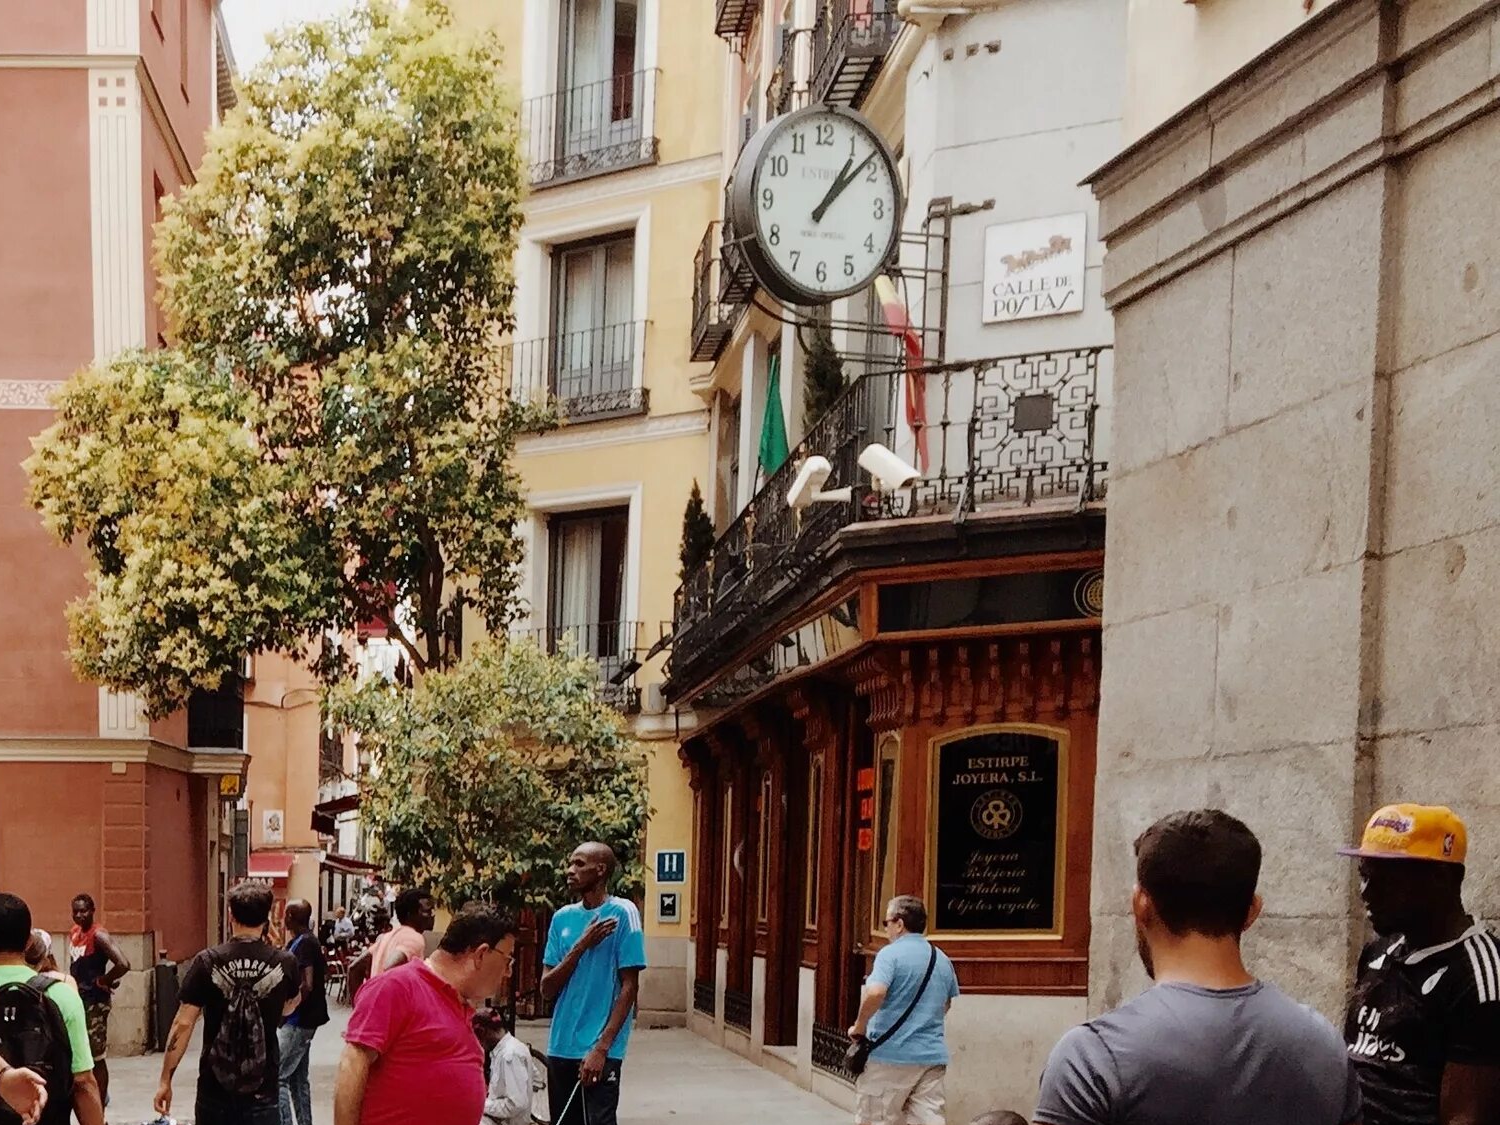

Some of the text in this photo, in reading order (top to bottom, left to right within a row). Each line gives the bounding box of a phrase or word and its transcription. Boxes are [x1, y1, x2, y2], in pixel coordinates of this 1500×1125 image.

[792, 133, 805, 154] 11
[815, 124, 834, 146] 12
[850, 135, 856, 157] 1
[770, 155, 788, 177] 10
[866, 162, 878, 183] 2
[762, 188, 773, 210] 9
[873, 198, 884, 220] 3
[769, 224, 780, 246] 8
[864, 233, 874, 253] 4
[789, 251, 801, 272] 7
[816, 261, 826, 283] 6
[844, 255, 854, 276] 5
[992, 276, 1072, 296] CALLE DE
[993, 290, 1074, 317] POSTAS
[968, 756, 1029, 769] ESTIRPE
